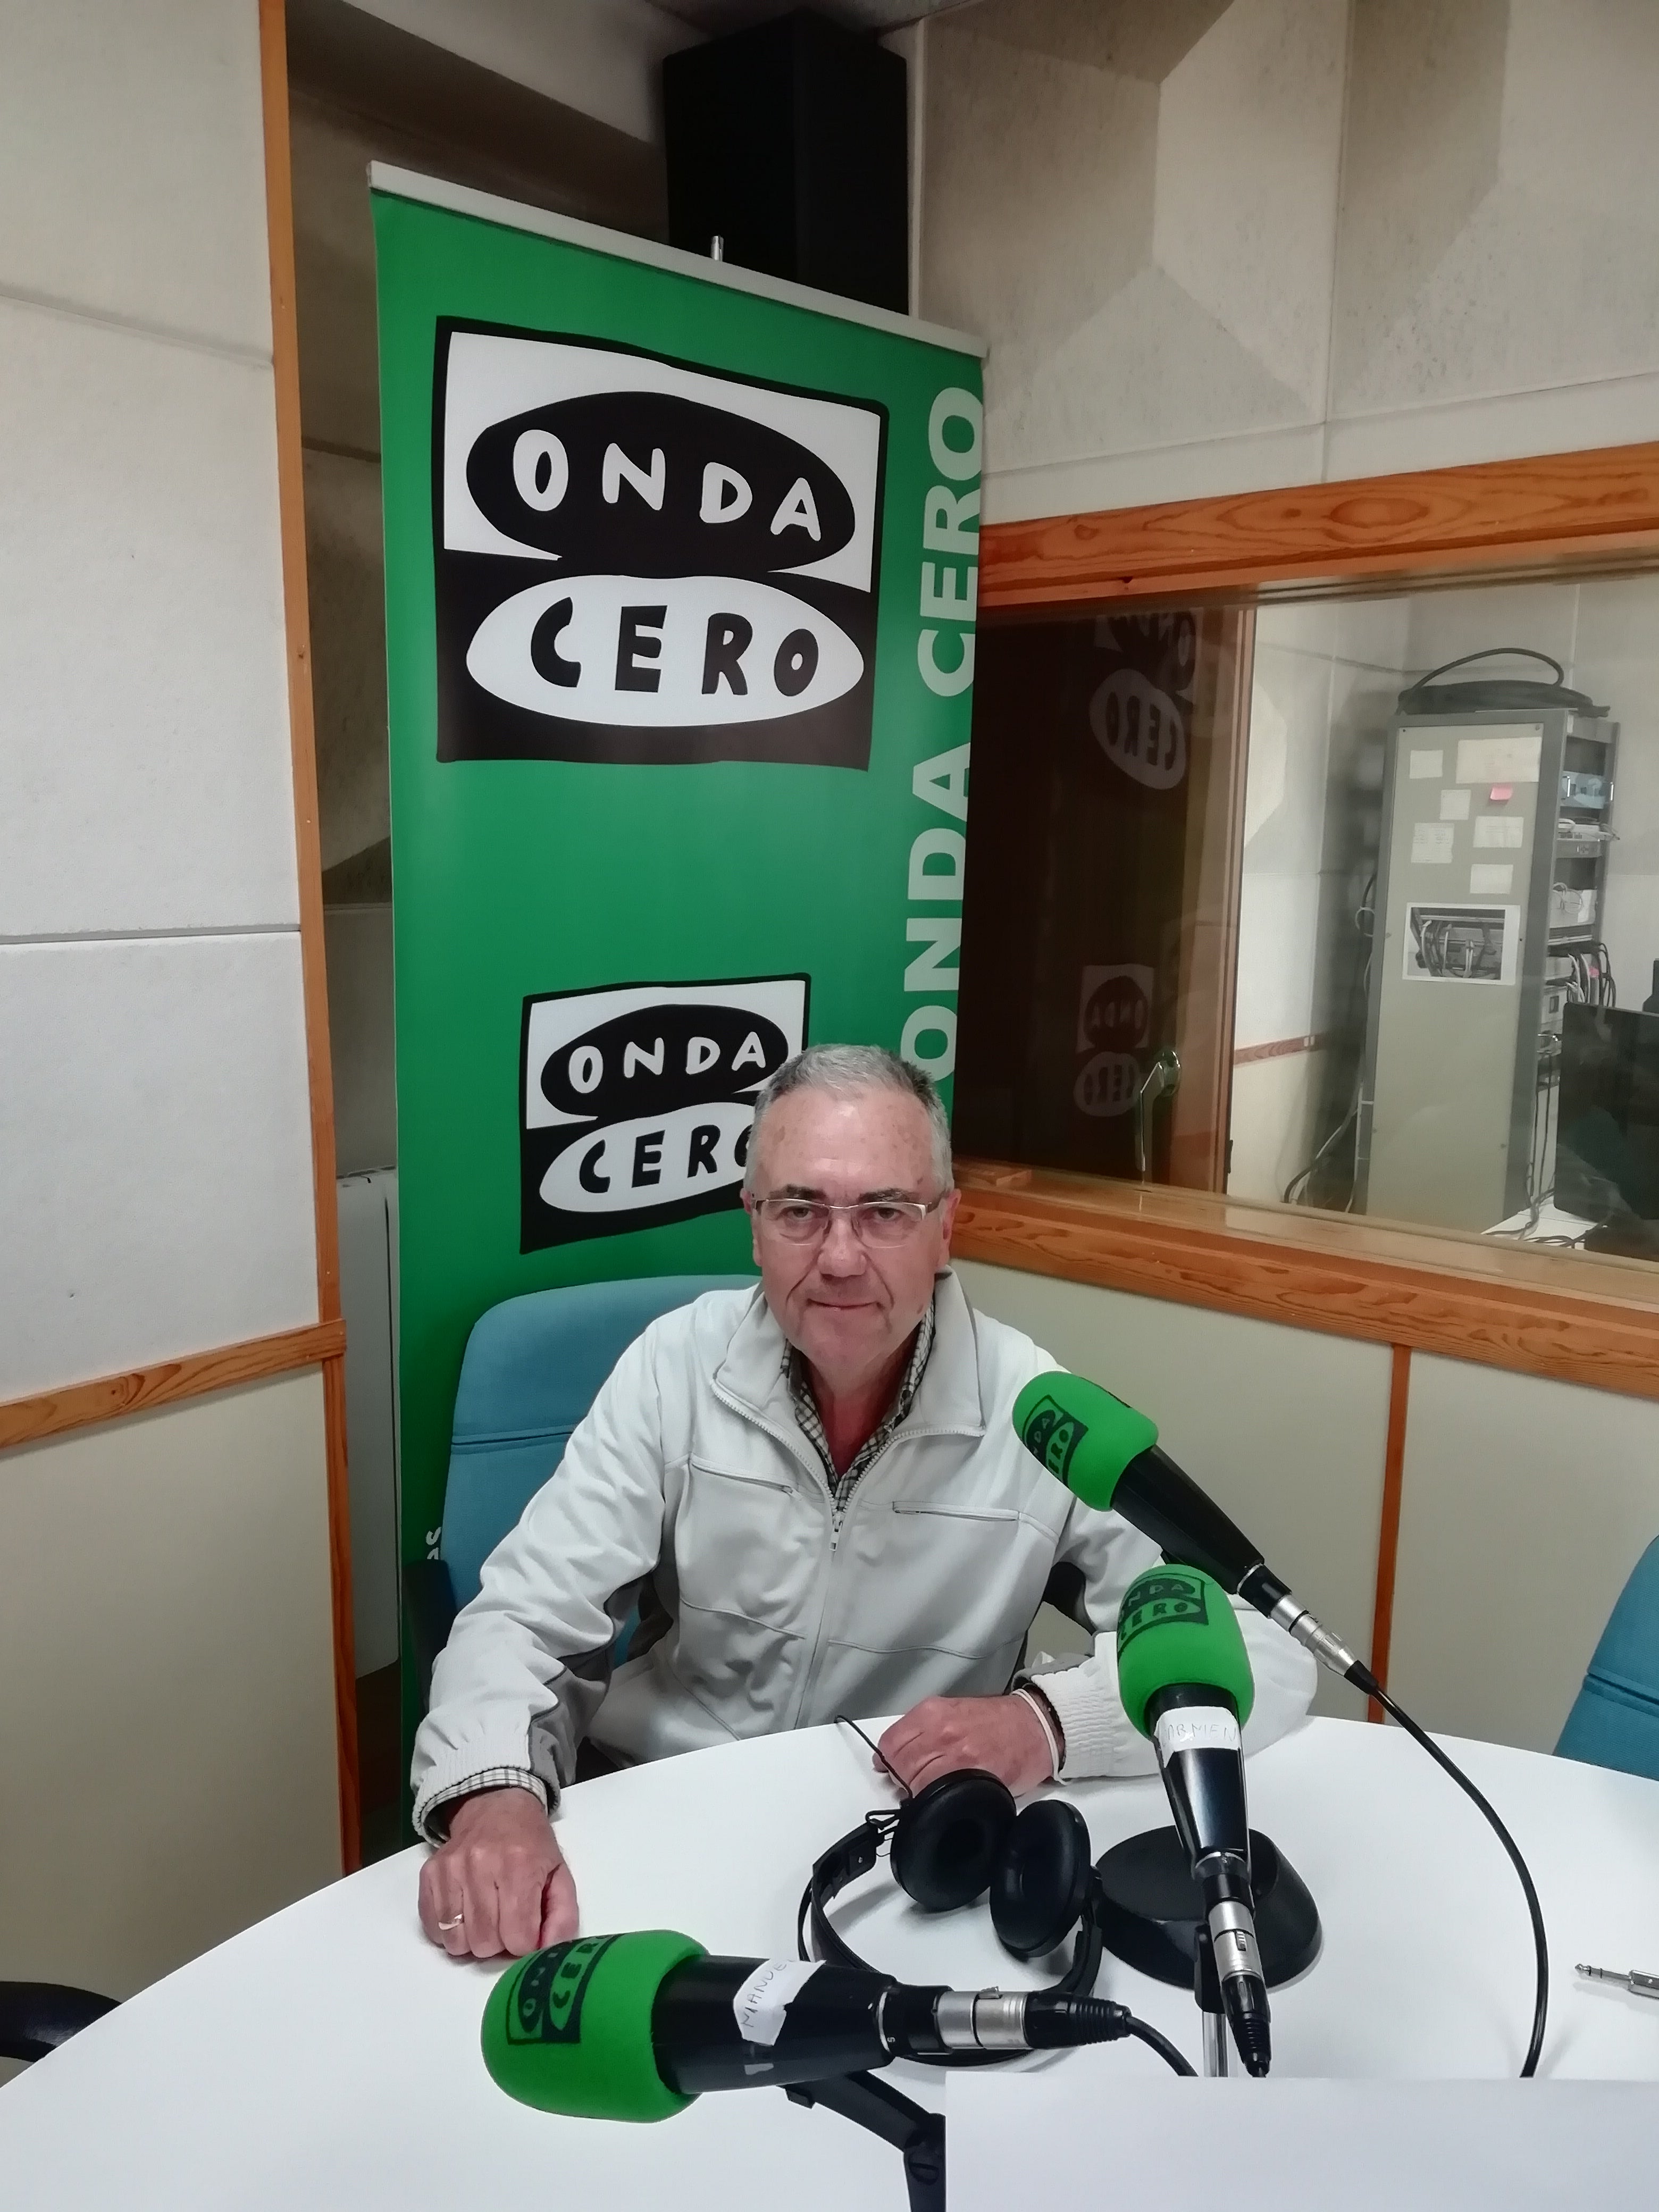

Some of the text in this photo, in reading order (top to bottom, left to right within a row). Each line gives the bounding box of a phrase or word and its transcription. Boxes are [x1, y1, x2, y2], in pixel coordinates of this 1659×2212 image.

[513, 429, 820, 541] ONDA
[530, 597, 819, 697] CERO
[901, 387, 983, 1082] ONDA CERO
[568, 1032, 766, 1093] ONDA
[1048, 1429, 1069, 1474] ERO
